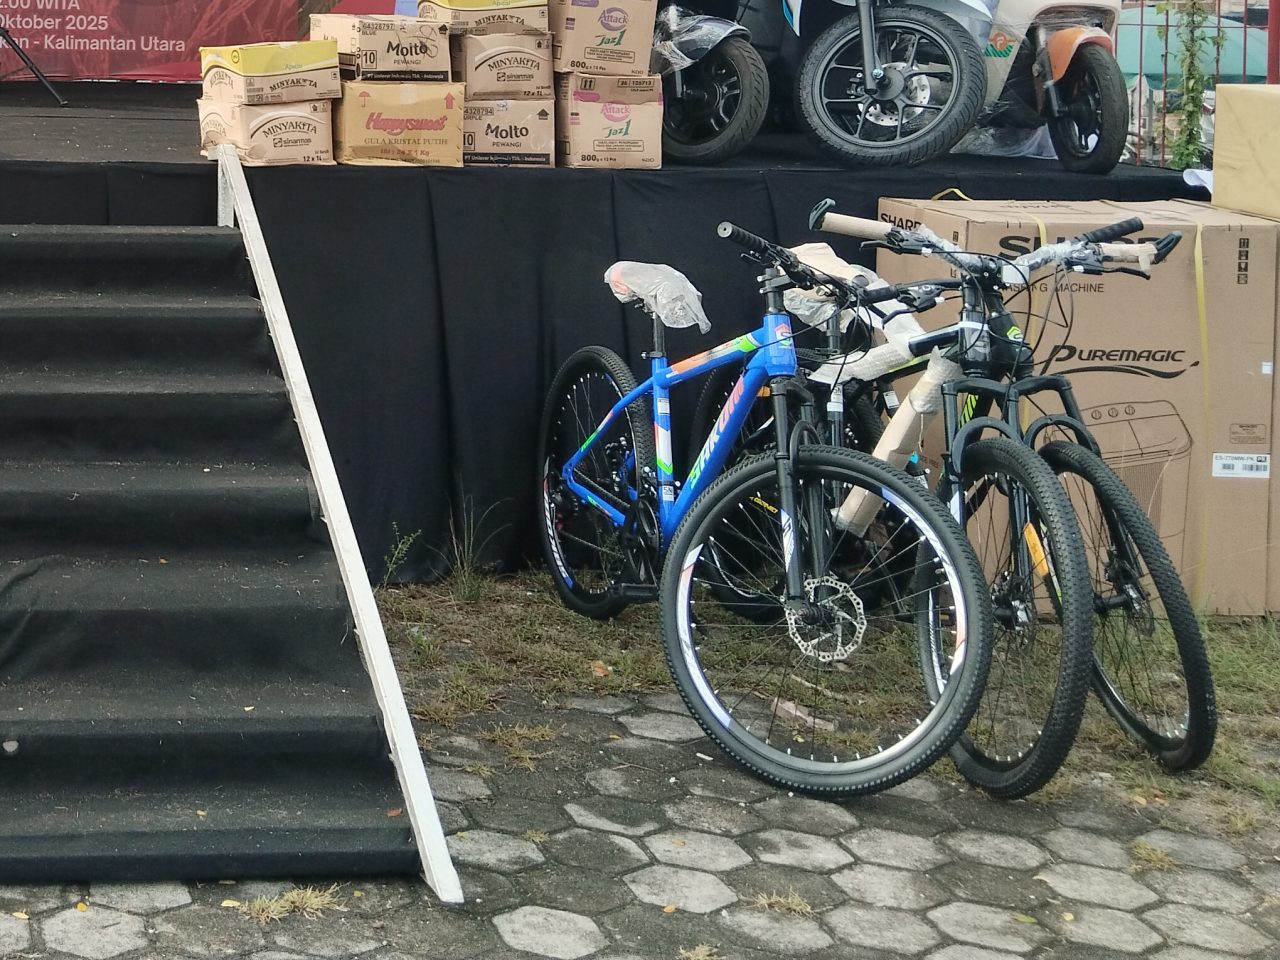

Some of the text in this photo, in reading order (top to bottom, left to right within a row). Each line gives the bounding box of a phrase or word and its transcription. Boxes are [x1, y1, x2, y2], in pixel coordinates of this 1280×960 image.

[65, 15, 109, 31] 2025
[598, 9, 629, 24] Attack
[44, 35, 136, 51] Kalimantan
[141, 37, 186, 52] Utara
[362, 52, 375, 64] 10
[487, 57, 540, 72] MINYAKITA
[463, 107, 494, 115] 4328794
[262, 121, 318, 139] MINYAKITA
[485, 123, 529, 139] Molto
[1041, 344, 1186, 376] PUREMAGIC
